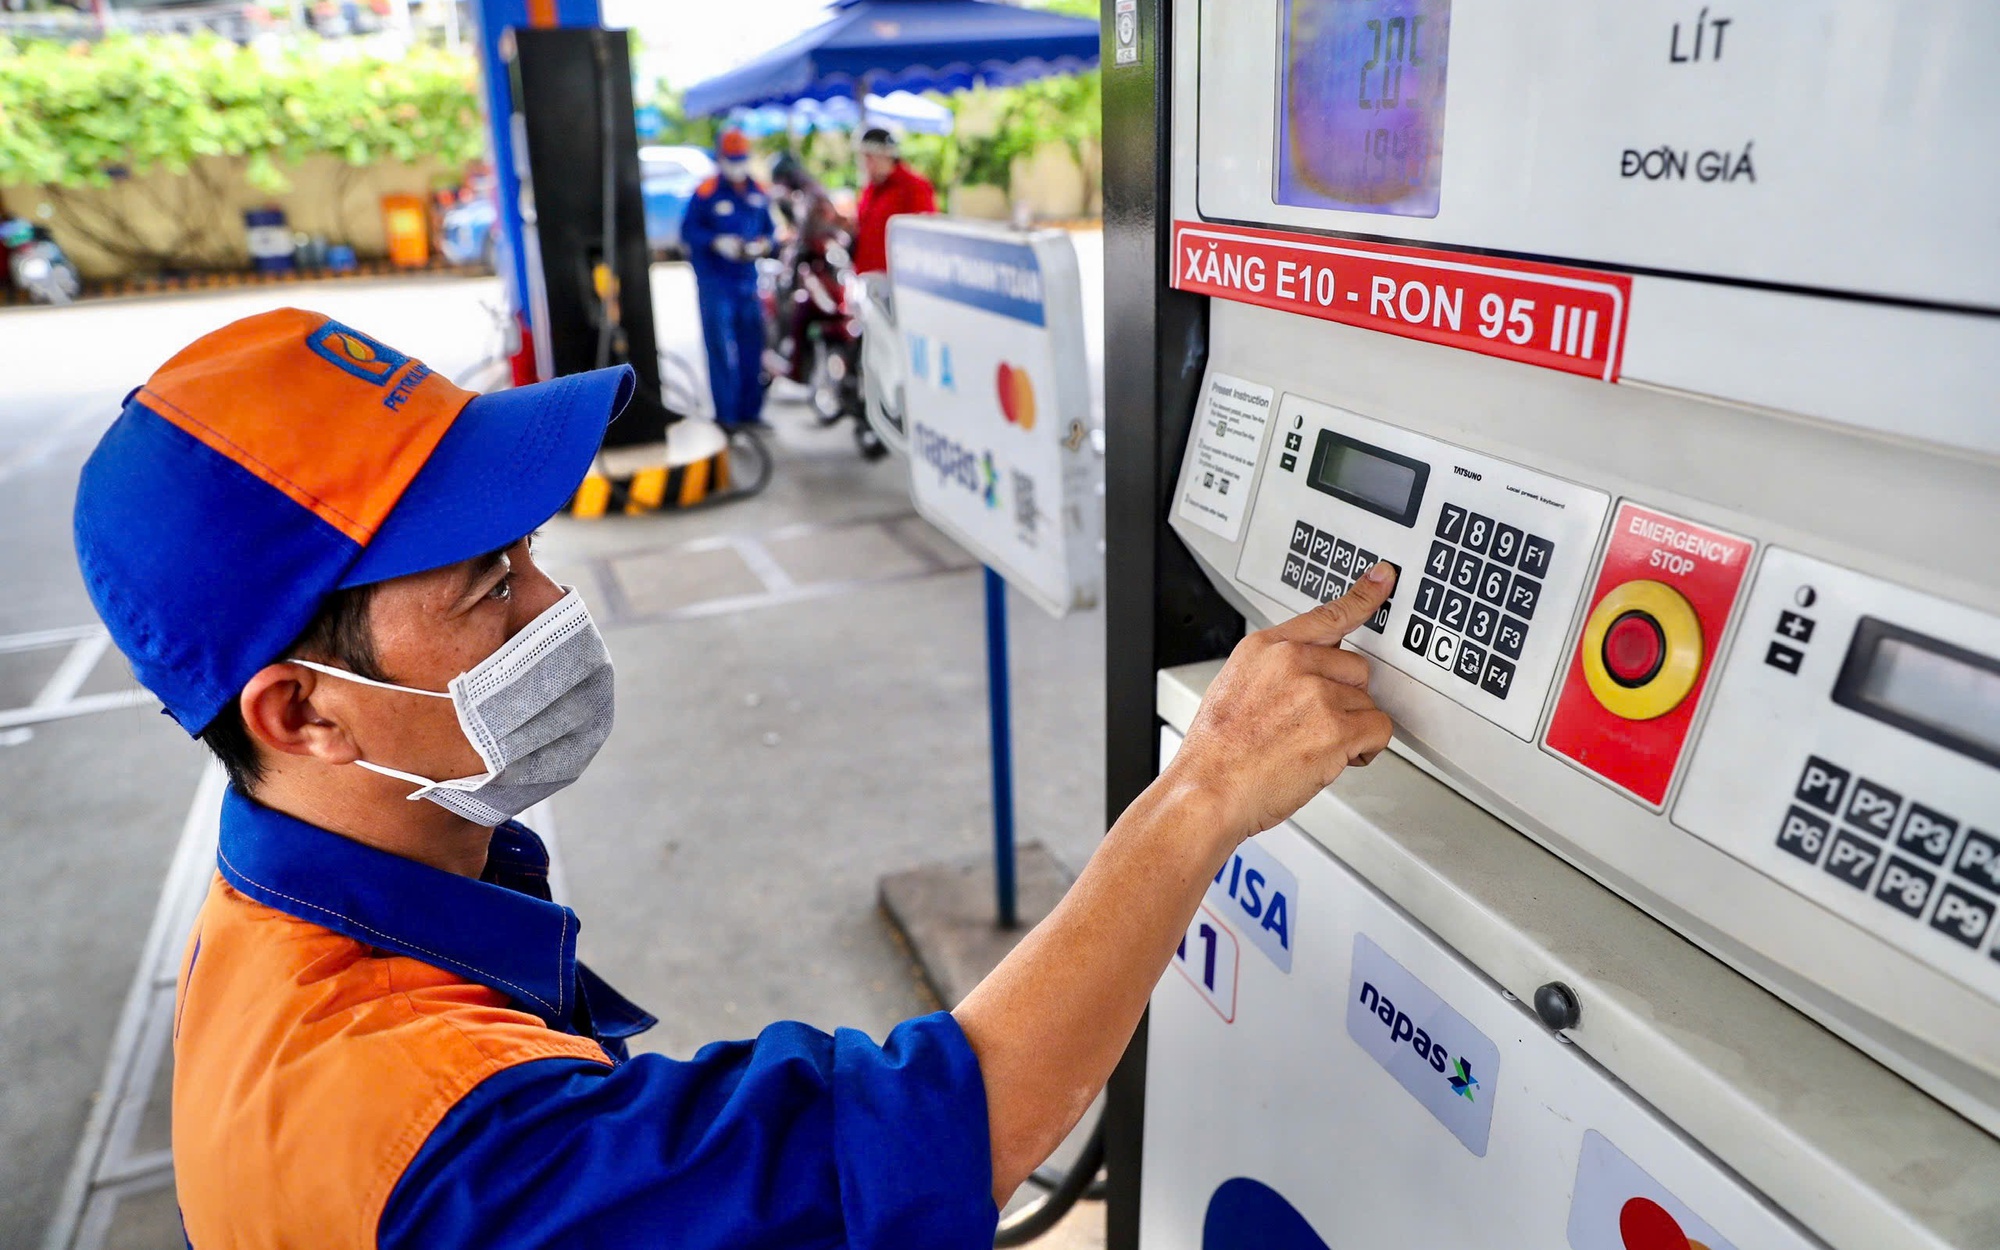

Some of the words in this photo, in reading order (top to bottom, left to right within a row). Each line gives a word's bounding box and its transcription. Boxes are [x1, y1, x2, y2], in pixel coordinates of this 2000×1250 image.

[1670, 6, 1732, 63] LÍT
[1621, 145, 1689, 181] ĐƠN
[1696, 139, 1757, 183] GIÁ
[1185, 241, 1265, 293] XĂNG
[1276, 261, 1335, 307] E10
[1346, 291, 1358, 302] -
[1370, 276, 1463, 331] RON
[1478, 292, 1534, 345] 95
[1549, 305, 1598, 360] III
[1210, 381, 1233, 399] Preset
[1233, 387, 1270, 409] Instruction
[1453, 466, 1482, 482] TATSUNO
[1539, 496, 1566, 509] keyboard
[1293, 527, 1310, 549] P1
[1313, 536, 1331, 559] P2
[1333, 546, 1352, 569] P3
[1444, 509, 1460, 535] 7
[1469, 520, 1486, 547] 8
[1497, 531, 1515, 558] 9
[1525, 544, 1545, 568] F1
[1629, 516, 1736, 566] EMERGENCY
[1650, 549, 1695, 577] STOP
[1284, 560, 1301, 582] P6
[1303, 570, 1322, 592] P7
[1432, 549, 1448, 574] 4
[1457, 561, 1475, 586] 5
[1485, 571, 1503, 599] 6
[1513, 585, 1534, 609] F2
[1423, 586, 1435, 611] 1
[1445, 599, 1463, 625] 2
[1473, 611, 1491, 638] 3
[1500, 625, 1521, 650] F3
[1410, 623, 1425, 649] 0
[1435, 636, 1453, 663] C
[1487, 666, 1509, 689] F4
[1801, 766, 1841, 804] P1
[1850, 788, 1896, 830] P2
[1902, 812, 1951, 856] P3
[1782, 815, 1823, 854] P6
[1830, 839, 1876, 878] P7
[1880, 865, 1929, 908] P8
[1935, 893, 1989, 938] P9
[1359, 981, 1448, 1073] napas
